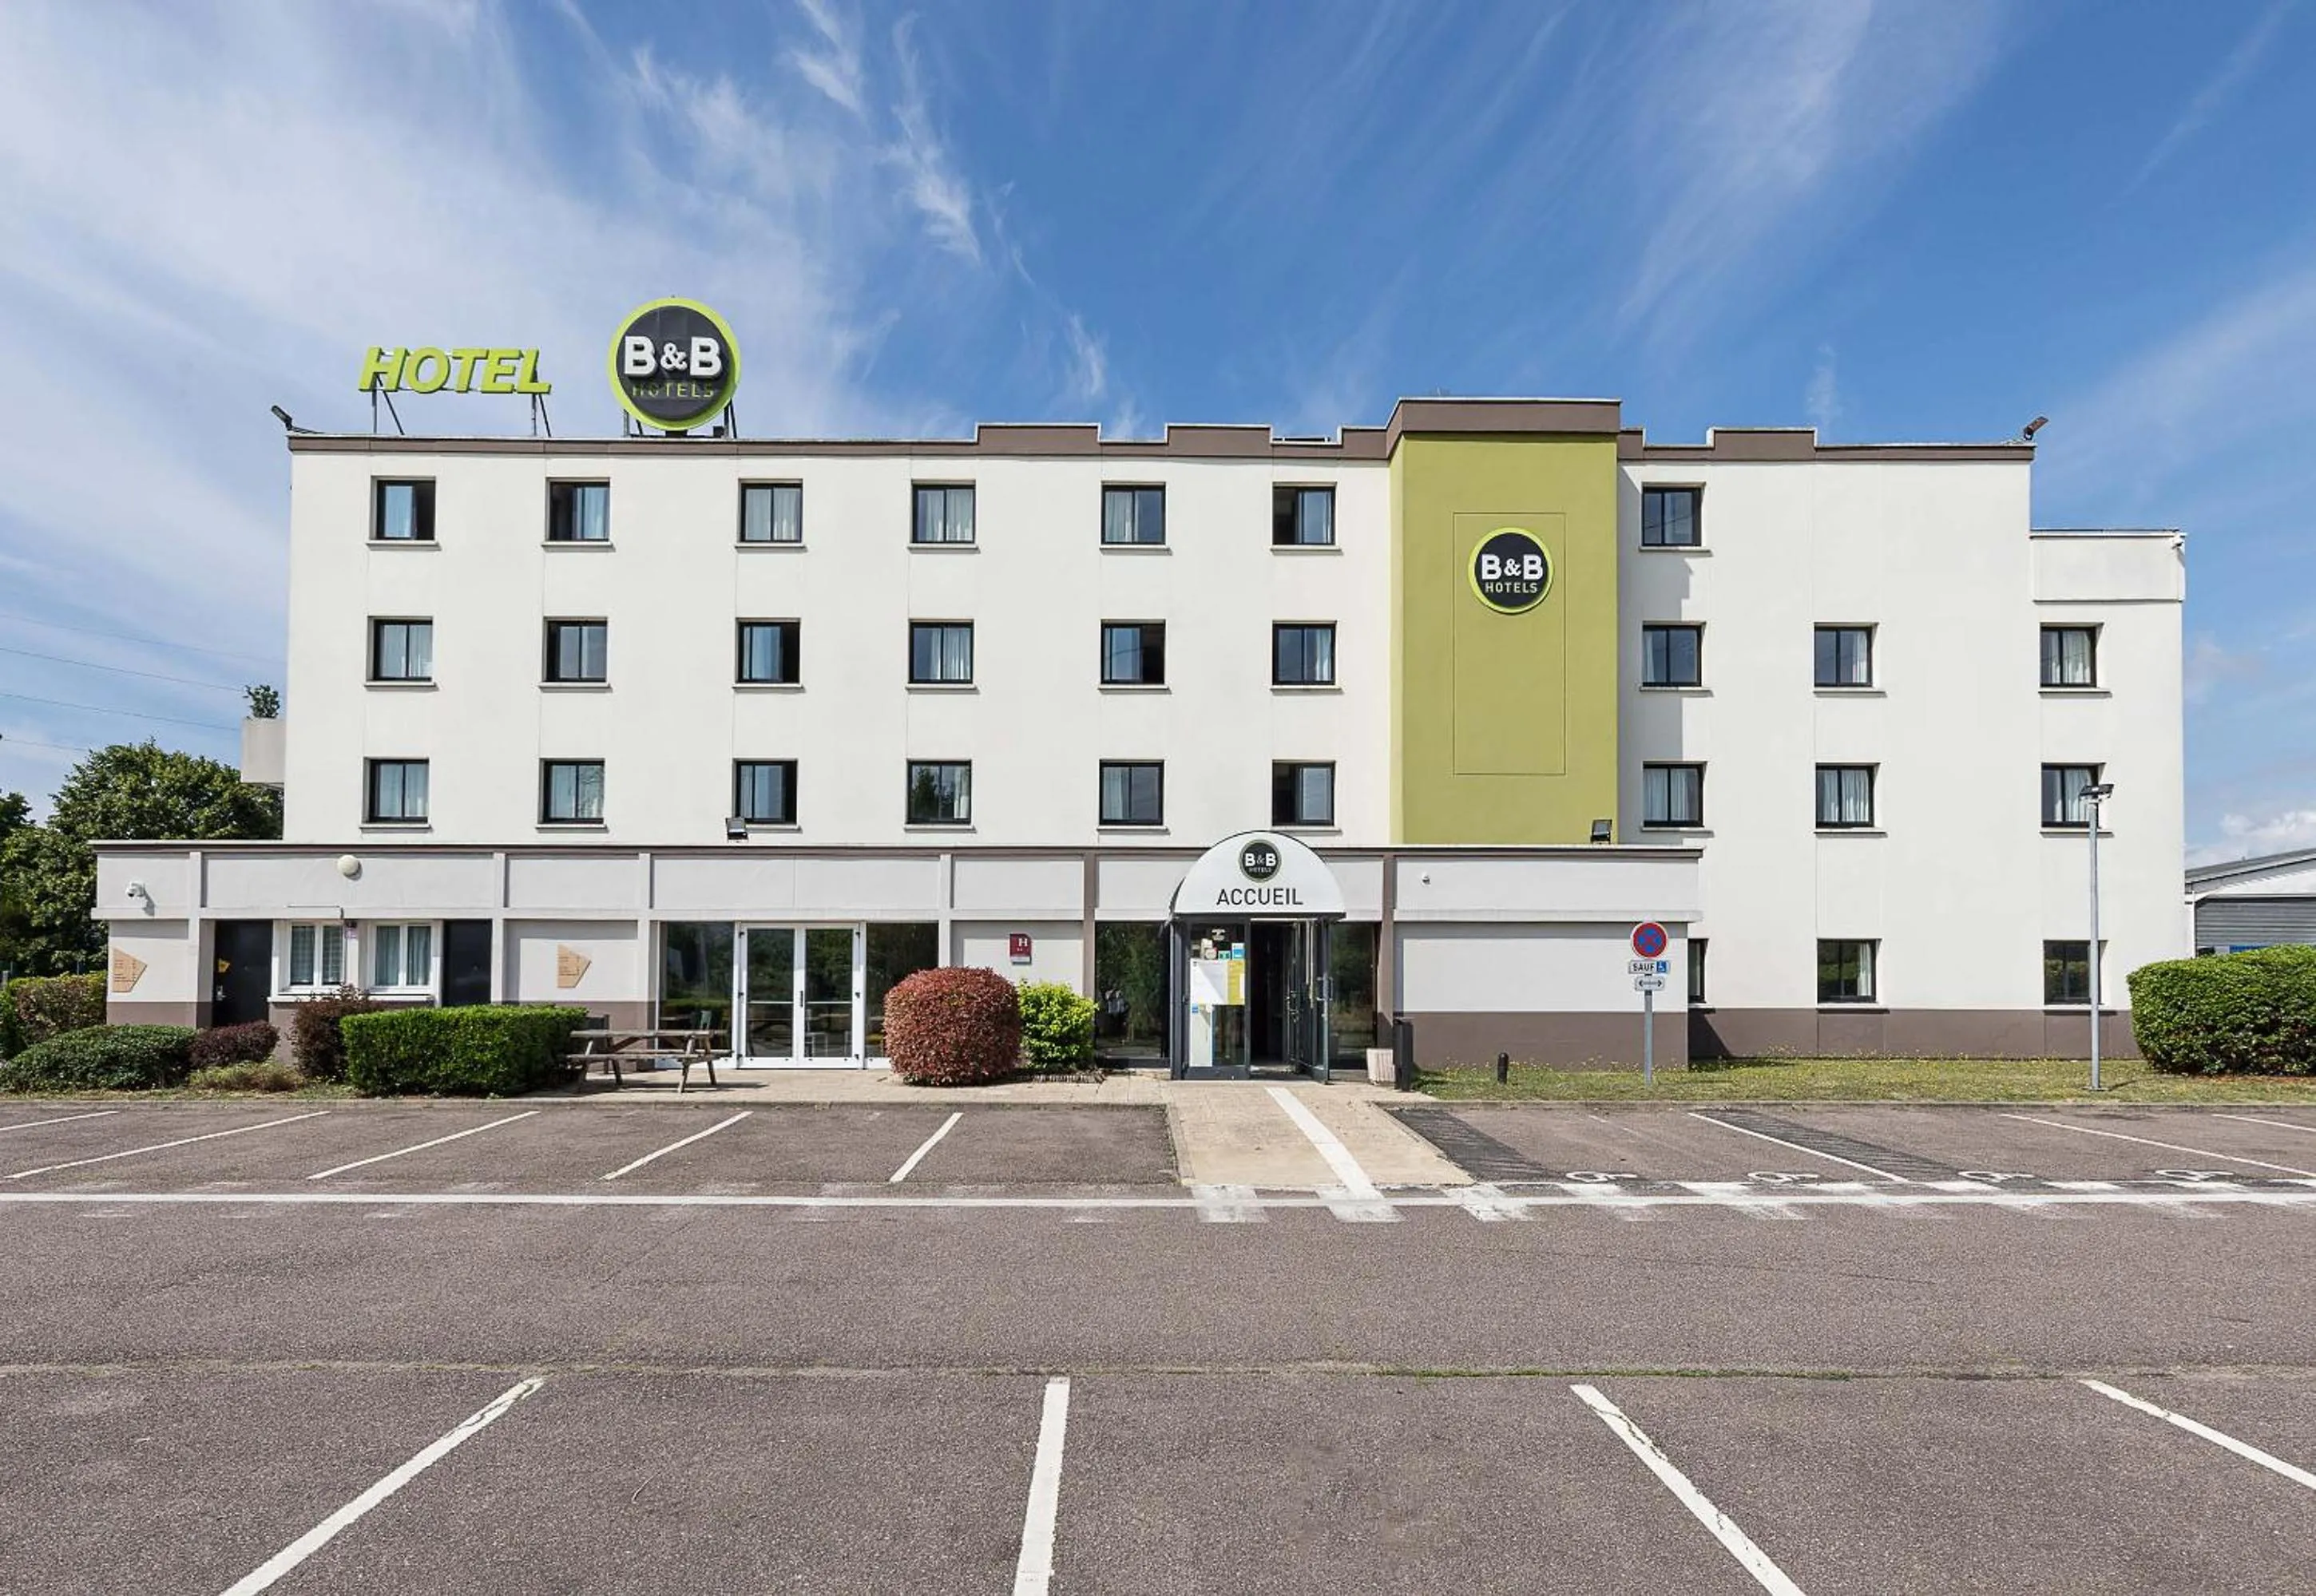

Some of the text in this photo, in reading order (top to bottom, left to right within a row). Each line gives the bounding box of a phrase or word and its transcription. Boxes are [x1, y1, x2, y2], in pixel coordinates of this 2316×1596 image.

[625, 336, 723, 377] B&B
[359, 347, 551, 394] HOTEL
[632, 383, 715, 398] HOTELS
[1481, 554, 1543, 580] B&B
[1485, 581, 1538, 593] HOTELS
[1246, 853, 1276, 866] B&B
[1216, 888, 1303, 905] ACCUEIL
[1018, 938, 1028, 947] H
[1632, 963, 1655, 972] SAUF
